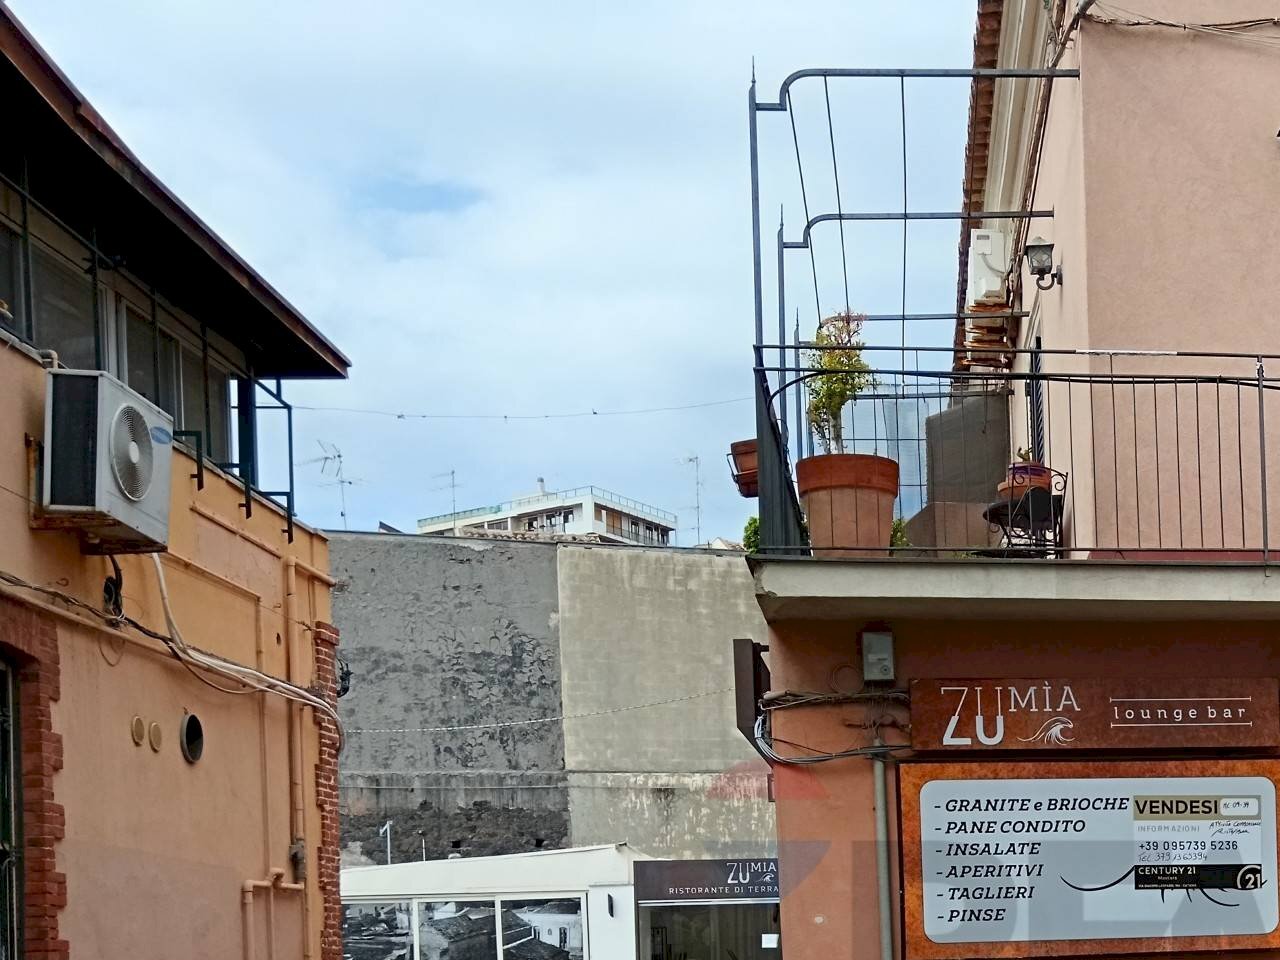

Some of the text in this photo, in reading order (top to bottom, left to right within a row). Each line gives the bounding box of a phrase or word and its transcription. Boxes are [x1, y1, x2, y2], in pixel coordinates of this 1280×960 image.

[1114, 706, 1246, 721] lounge bar
[945, 797, 1129, 812] GRANITE e BRIOCHE
[1135, 799, 1218, 814] VENDESI
[945, 819, 1086, 834] PANE CONDITO
[945, 842, 1041, 856] INSALATE
[1139, 840, 1238, 851] +39 095739 5236
[945, 864, 1044, 878] APERITIVI
[1138, 866, 1196, 875] CENTURY 21
[669, 886, 730, 895] RISTORANTE
[748, 885, 779, 893] TERRA
[948, 886, 1035, 900] TAGLIERI
[947, 908, 1006, 922] PINSE
